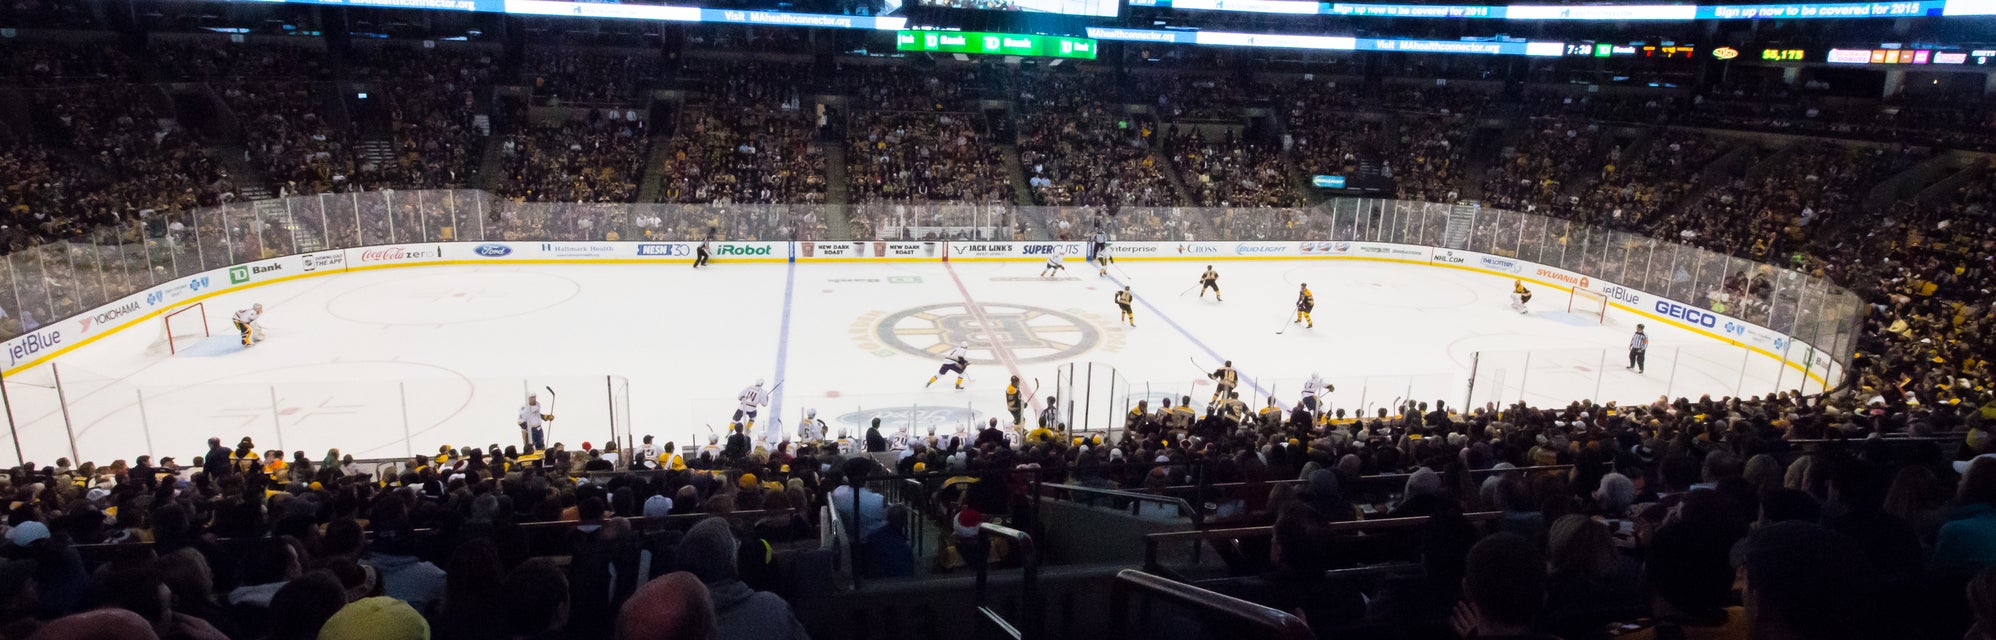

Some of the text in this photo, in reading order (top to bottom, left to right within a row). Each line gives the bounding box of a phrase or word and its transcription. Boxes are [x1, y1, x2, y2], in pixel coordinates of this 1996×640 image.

[1333, 3, 1488, 16] Sign up now to be covered for 2015
[1714, 3, 1919, 19] Sign up now to be covered for 2015
[724, 11, 851, 27] Visit MAhealthconnector.org
[940, 35, 966, 46] Bank
[1087, 28, 1176, 42] MAhealthconnector.org
[1003, 37, 1032, 48] Bank
[1376, 40, 1500, 54] Visit MAhealthconnector.org
[405, 250, 434, 259] zero
[480, 245, 505, 256] Ford
[642, 245, 669, 255] NESN
[716, 244, 772, 256] iRobot
[1433, 255, 1465, 264] NHL.COM
[252, 262, 283, 275] Bank
[1536, 268, 1579, 285] SYLVANIA
[94, 301, 140, 326] YOKOHAMA
[1655, 300, 1717, 328] GEICO
[8, 330, 61, 366] jetBlue
[746, 390, 758, 402] 14
